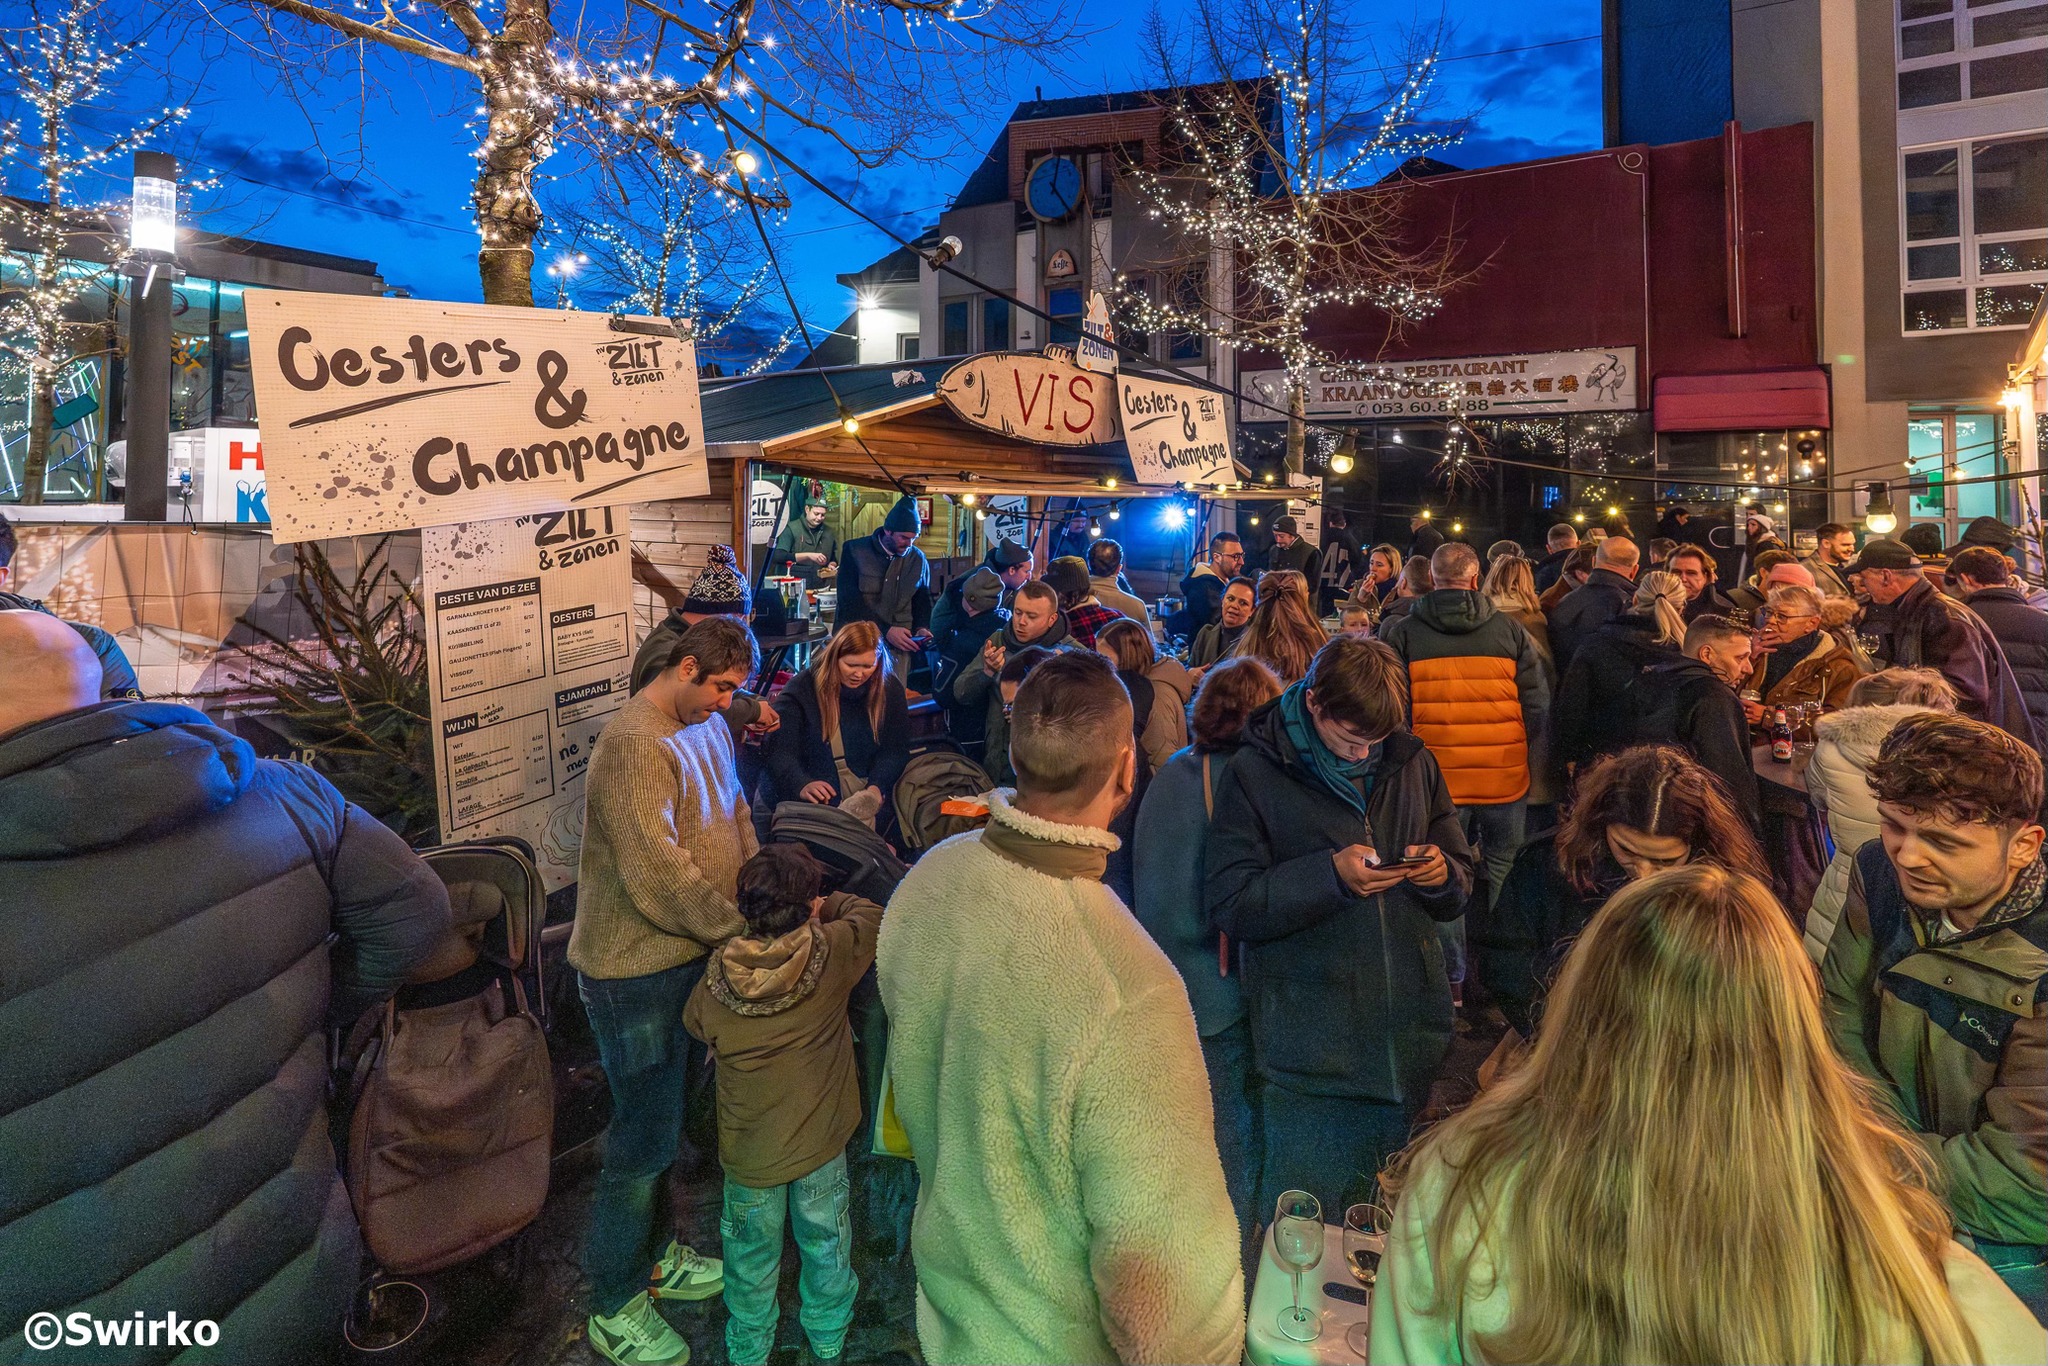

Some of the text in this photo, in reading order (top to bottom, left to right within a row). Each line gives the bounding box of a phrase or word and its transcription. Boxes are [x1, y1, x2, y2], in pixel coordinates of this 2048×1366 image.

[1083, 340, 1114, 360] ZONEN
[278, 326, 521, 392] Oesters
[534, 350, 588, 429] &
[606, 340, 663, 369] ZILT
[612, 371, 665, 386] & zonen
[1014, 368, 1095, 434] VIS
[1372, 399, 1489, 415] 053 60.8.88
[1124, 384, 1178, 415] Oesters
[1181, 400, 1199, 442] &
[412, 421, 690, 496] Champagne
[1158, 440, 1226, 470] Champagne
[995, 505, 1024, 527] ZIL
[539, 538, 620, 571] & zonen
[439, 581, 535, 605] BESTE VAN DE ZEE
[552, 608, 594, 624] OESTERS
[447, 624, 482, 635] KAASKROKET
[450, 680, 482, 692] ESCARGOTS
[559, 683, 608, 703] SJAMPANJ
[446, 717, 476, 733] WIJN
[558, 743, 579, 760] ne
